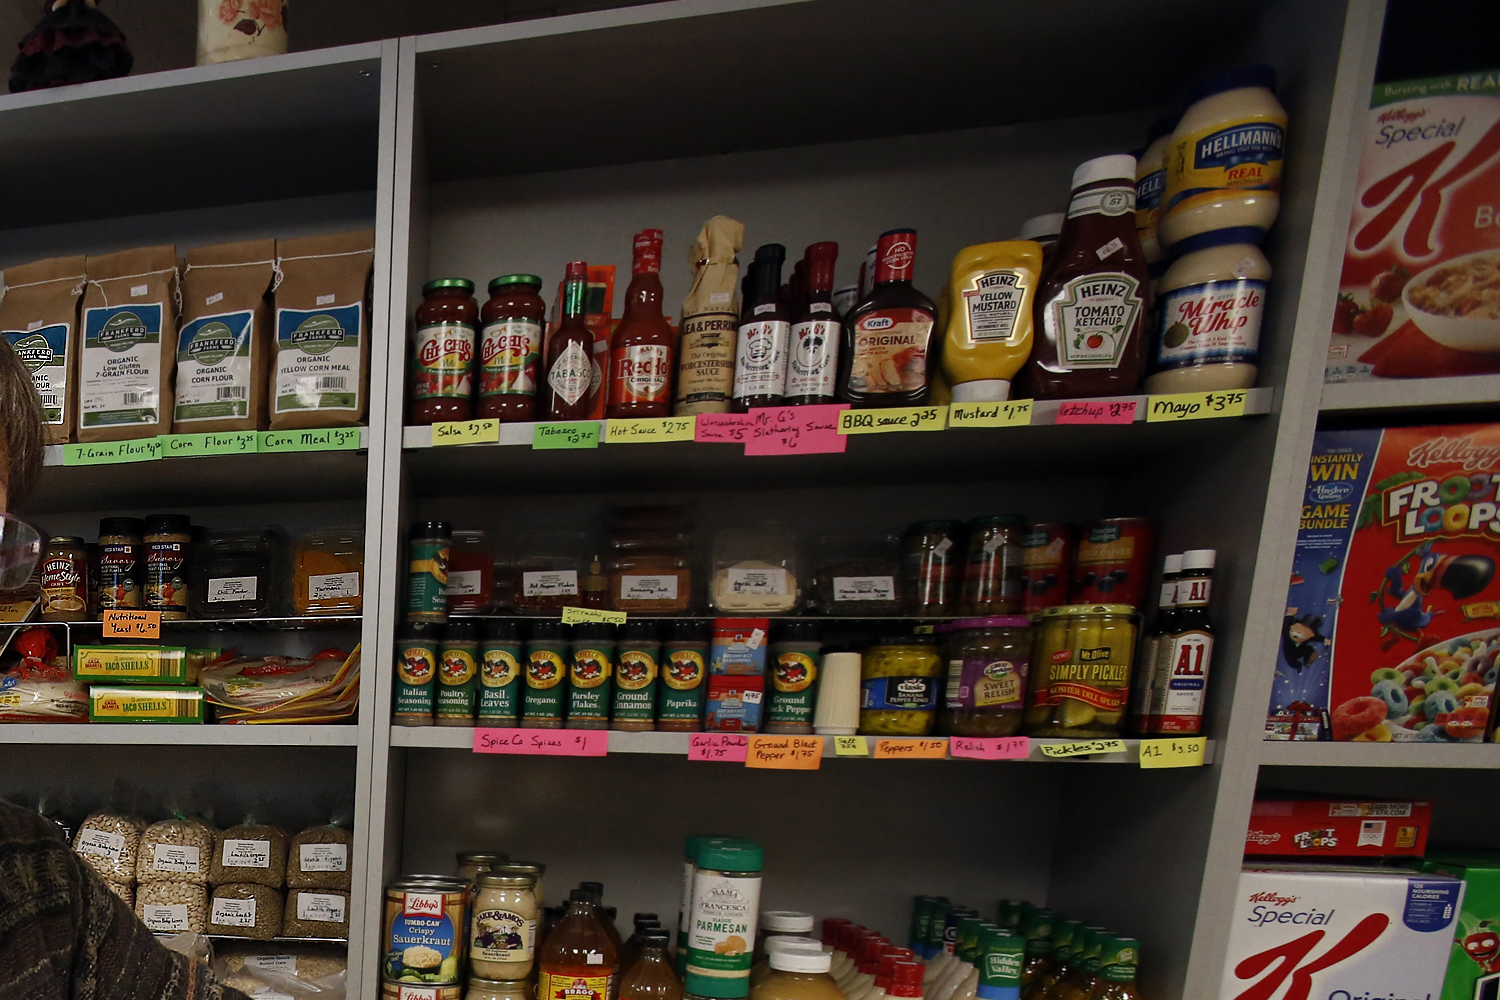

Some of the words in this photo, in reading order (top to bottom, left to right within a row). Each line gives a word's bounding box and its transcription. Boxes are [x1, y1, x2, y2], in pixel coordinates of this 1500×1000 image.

[1383, 83, 1429, 96] Bursting
[1429, 81, 1453, 91] with
[1374, 117, 1467, 148] Special
[1201, 130, 1282, 159] HELLMANN'S
[1227, 167, 1263, 180] REAL
[980, 274, 1016, 289] HEINZ
[1080, 284, 1127, 298] HEINZ
[978, 292, 1014, 302] YELLOW
[972, 301, 1017, 312] MUSTARD
[1074, 306, 1125, 317] TOMATO
[1178, 292, 1260, 320] Miracle
[866, 319, 889, 328] Kraft
[1074, 316, 1123, 327] KETCHUP
[1188, 312, 1248, 335] Whip
[857, 335, 916, 346] ORIGINAL
[296, 355, 331, 363] ORGANIC
[94, 370, 124, 378] 7-GRAIN
[279, 365, 307, 374] YELLOW
[307, 364, 328, 372] CORN
[328, 363, 351, 372] MEAL
[550, 369, 591, 379] TABASCO
[695, 368, 720, 376] SAUCE
[190, 375, 213, 383] CORN
[212, 374, 235, 382] FLOUR
[954, 408, 999, 419] Mustard
[1153, 401, 1201, 422] Mayo
[842, 416, 874, 428] BBQ
[875, 416, 908, 426] sauce
[437, 426, 462, 435] Salsa
[610, 427, 628, 435] Hot
[630, 425, 657, 434] Sauce
[264, 435, 294, 446] Corn
[300, 432, 331, 445] Meal
[1309, 454, 1364, 464] INSTANTLY
[1309, 464, 1359, 482] WIN
[104, 661, 120, 671] TACO
[120, 659, 150, 670] SHELLS
[1175, 644, 1204, 675] A1
[1049, 665, 1089, 681] SIMPLY
[1090, 663, 1128, 681] PICKLES
[983, 680, 1015, 691] SWEET
[402, 689, 428, 697] Italian
[483, 690, 506, 699] Basil
[571, 692, 600, 701] Parsley
[616, 692, 649, 701] Ground
[983, 687, 1017, 699] RELISH
[480, 699, 510, 708] Leaves
[525, 696, 557, 706] Oregano
[666, 700, 698, 709] Paprika
[773, 696, 806, 704] Ground
[121, 702, 137, 712] TACO
[137, 702, 168, 712] SHELLS
[879, 742, 913, 752] Peppers
[1044, 743, 1092, 754] Pickles
[754, 749, 786, 760] Pepper
[1248, 892, 1298, 906] Kellogg's
[700, 902, 747, 911] FRANCESCA
[1247, 905, 1336, 927] Special
[403, 919, 441, 927] JUMBO-CAN
[696, 920, 748, 934] PARMESAN
[408, 927, 436, 936] Crispy
[392, 934, 452, 946] Sauerkraut
[989, 956, 1021, 966] Hidden
[989, 965, 1018, 974] Valley
[564, 988, 595, 996] BRAGG
